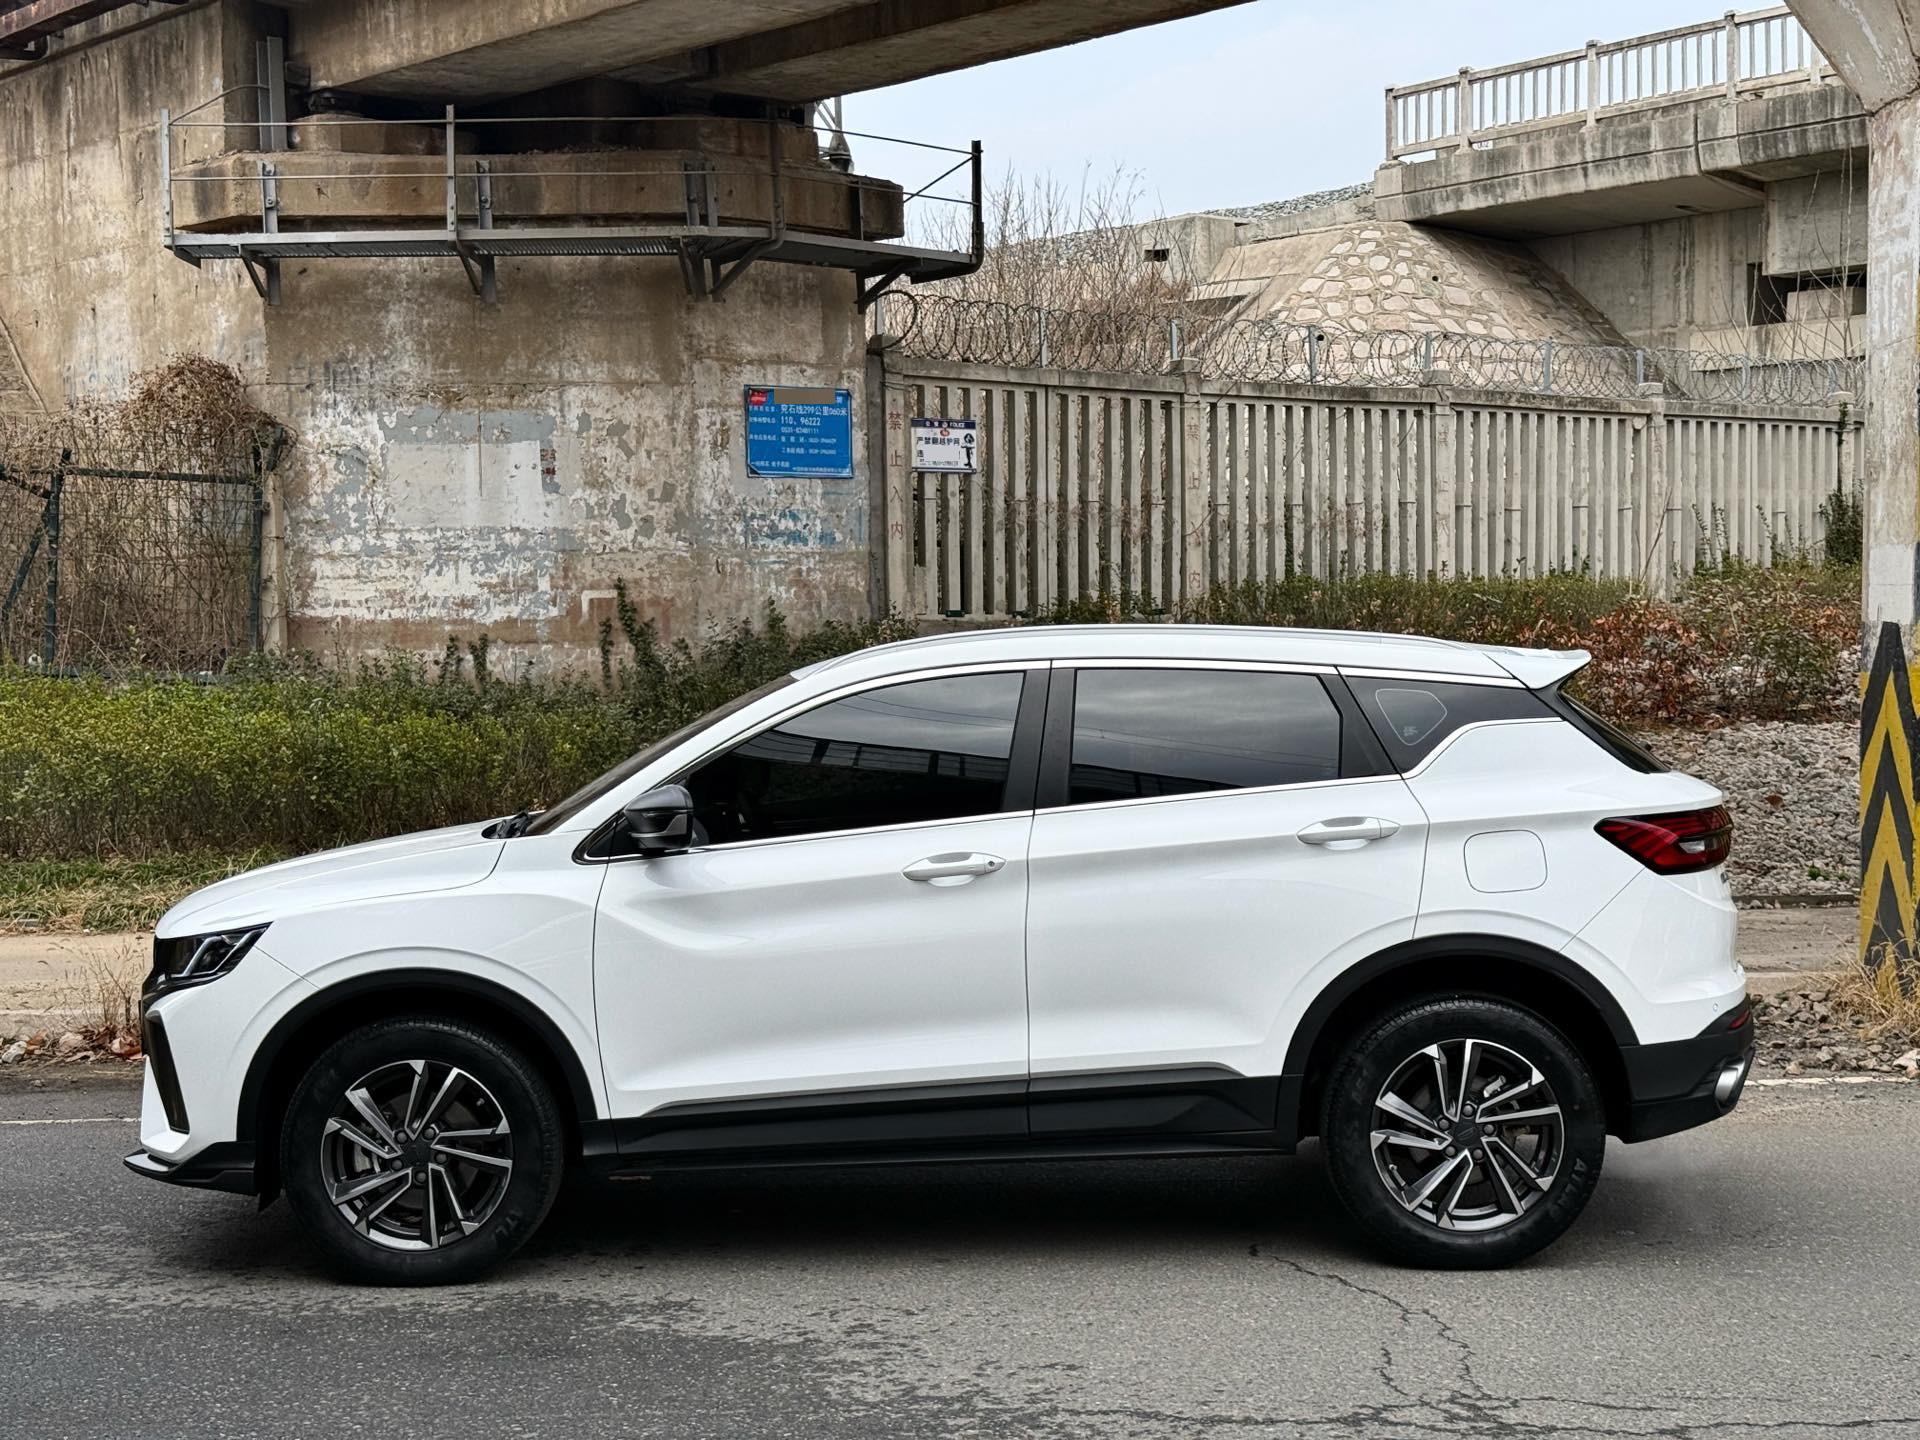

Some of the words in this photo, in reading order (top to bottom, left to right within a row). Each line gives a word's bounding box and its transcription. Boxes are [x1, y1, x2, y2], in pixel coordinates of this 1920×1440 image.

[888, 411, 904, 541] 禁止入内
[916, 436, 960, 446] 严禁翻越护网
[1186, 423, 1203, 589] 禁止入内
